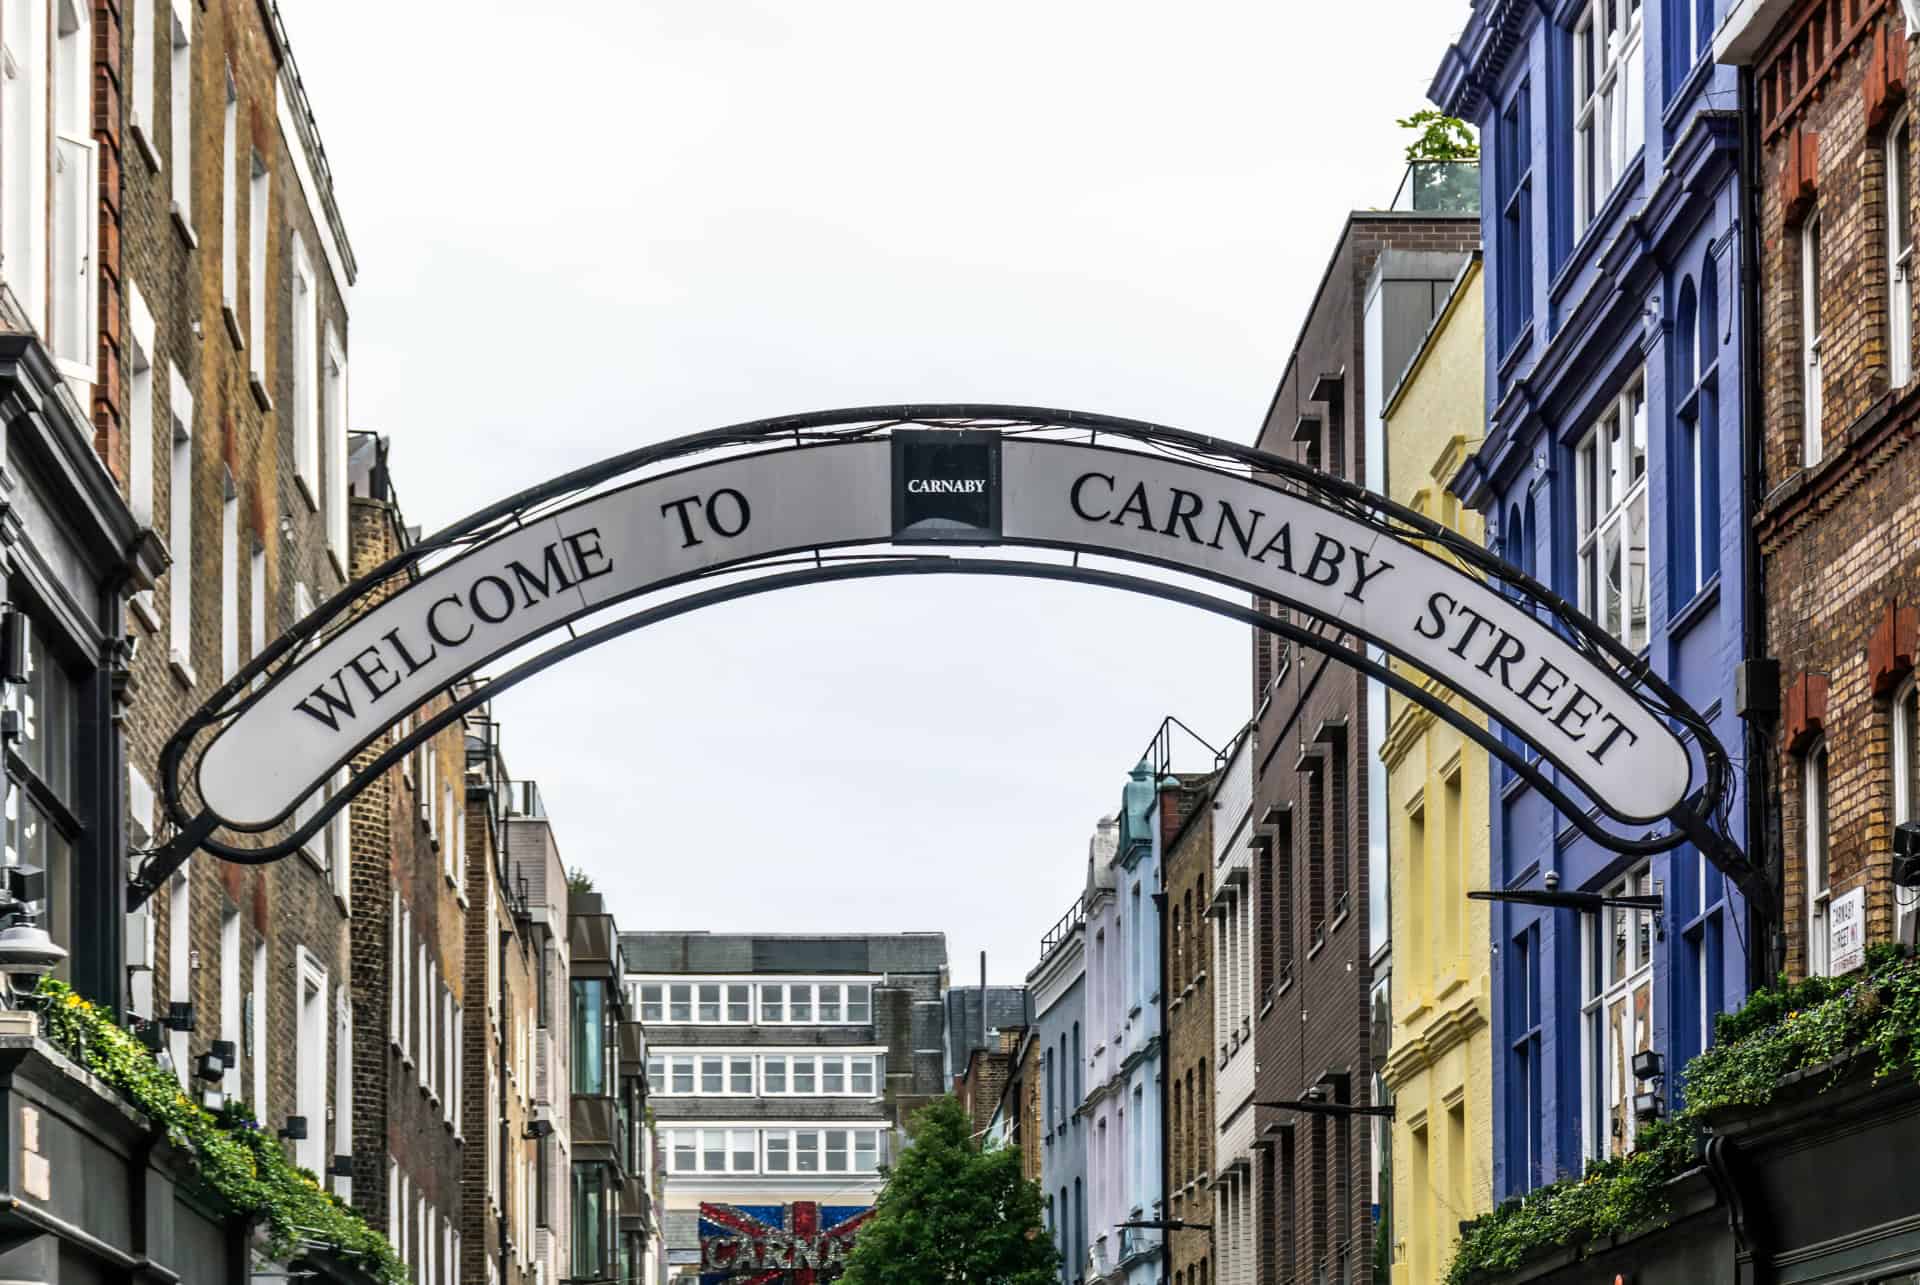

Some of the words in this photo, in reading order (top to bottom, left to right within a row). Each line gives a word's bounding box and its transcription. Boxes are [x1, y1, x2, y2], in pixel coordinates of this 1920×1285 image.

[907, 479, 986, 493] CARNABY
[294, 527, 613, 731] WELCOME
[661, 487, 751, 548] TO
[1070, 471, 1394, 603] CARNABY
[1414, 591, 1637, 765] STREET
